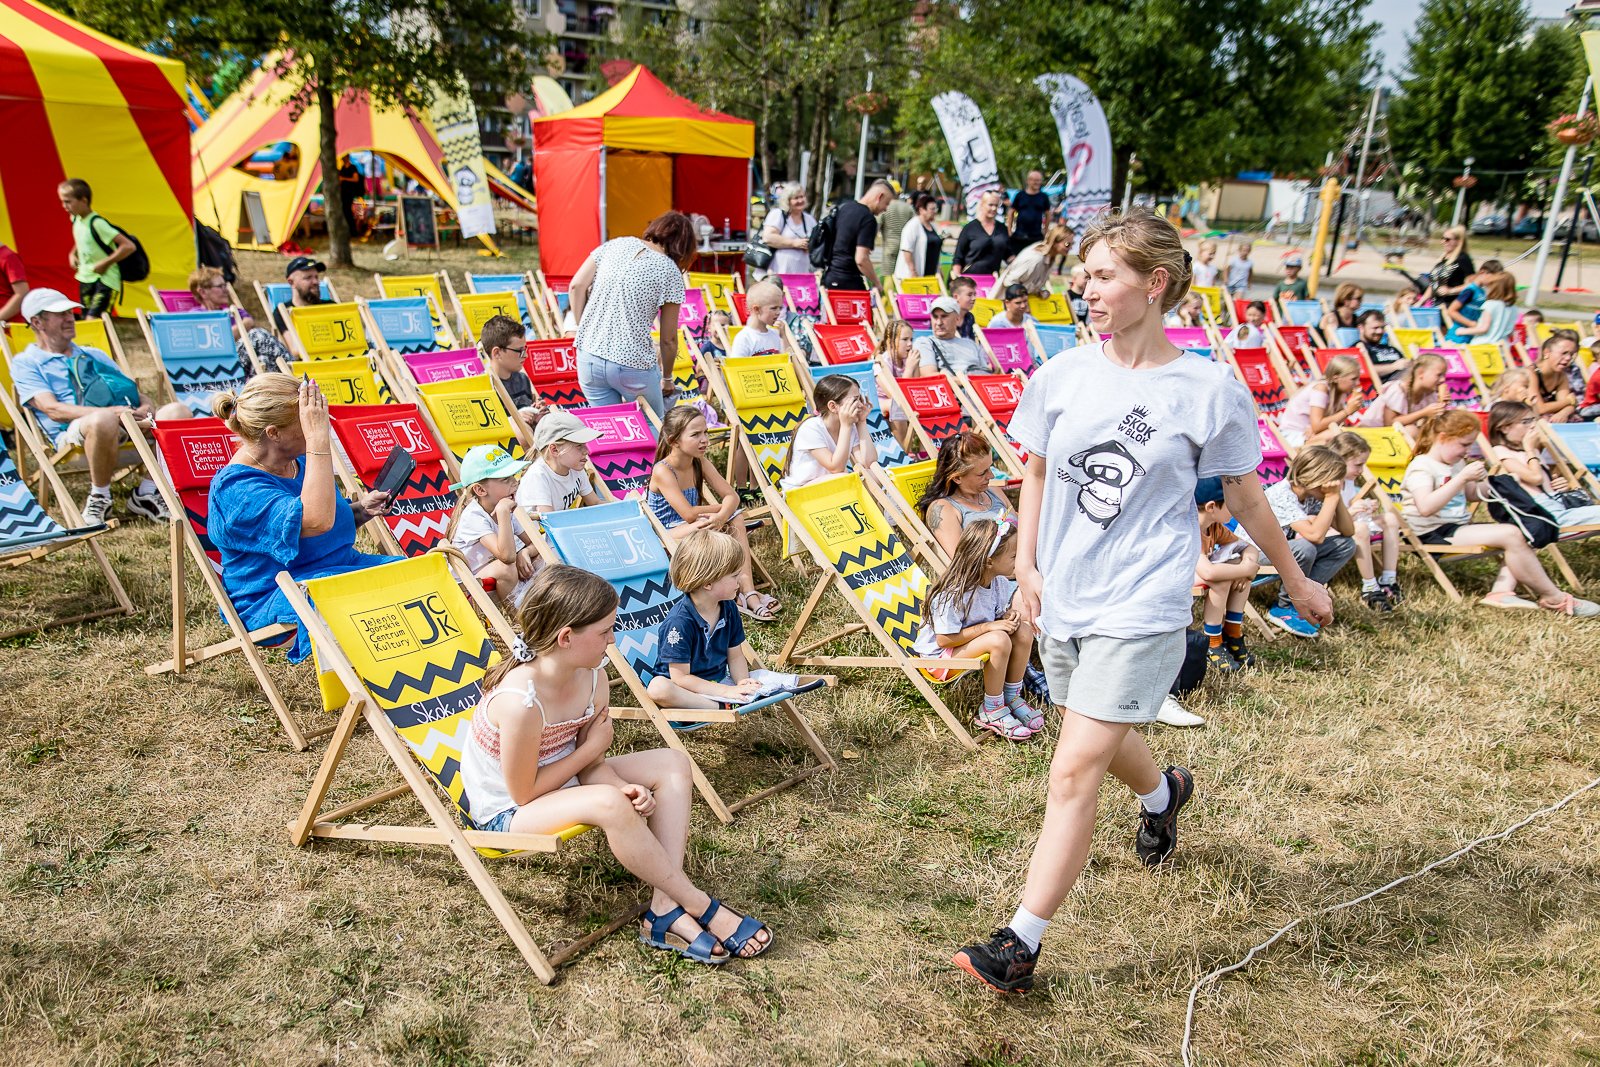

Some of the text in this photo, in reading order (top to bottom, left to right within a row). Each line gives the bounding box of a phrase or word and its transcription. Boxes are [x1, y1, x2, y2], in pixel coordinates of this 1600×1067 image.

[363, 427, 388, 439] Jelenio
[1117, 423, 1127, 432] W
[1125, 427, 1149, 446] BLOK
[1122, 414, 1158, 440] SKOK
[369, 439, 394, 447] Centrum
[757, 431, 781, 445] Skok
[188, 441, 221, 454] Jelenio
[192, 454, 226, 463] Centrum
[391, 499, 421, 516] Skok
[852, 567, 882, 587] Skok
[360, 614, 397, 631] Jelenio
[615, 612, 644, 632] Skok
[369, 629, 406, 643] Centrum
[373, 639, 410, 653] Kultury
[410, 694, 476, 724] Skok w
